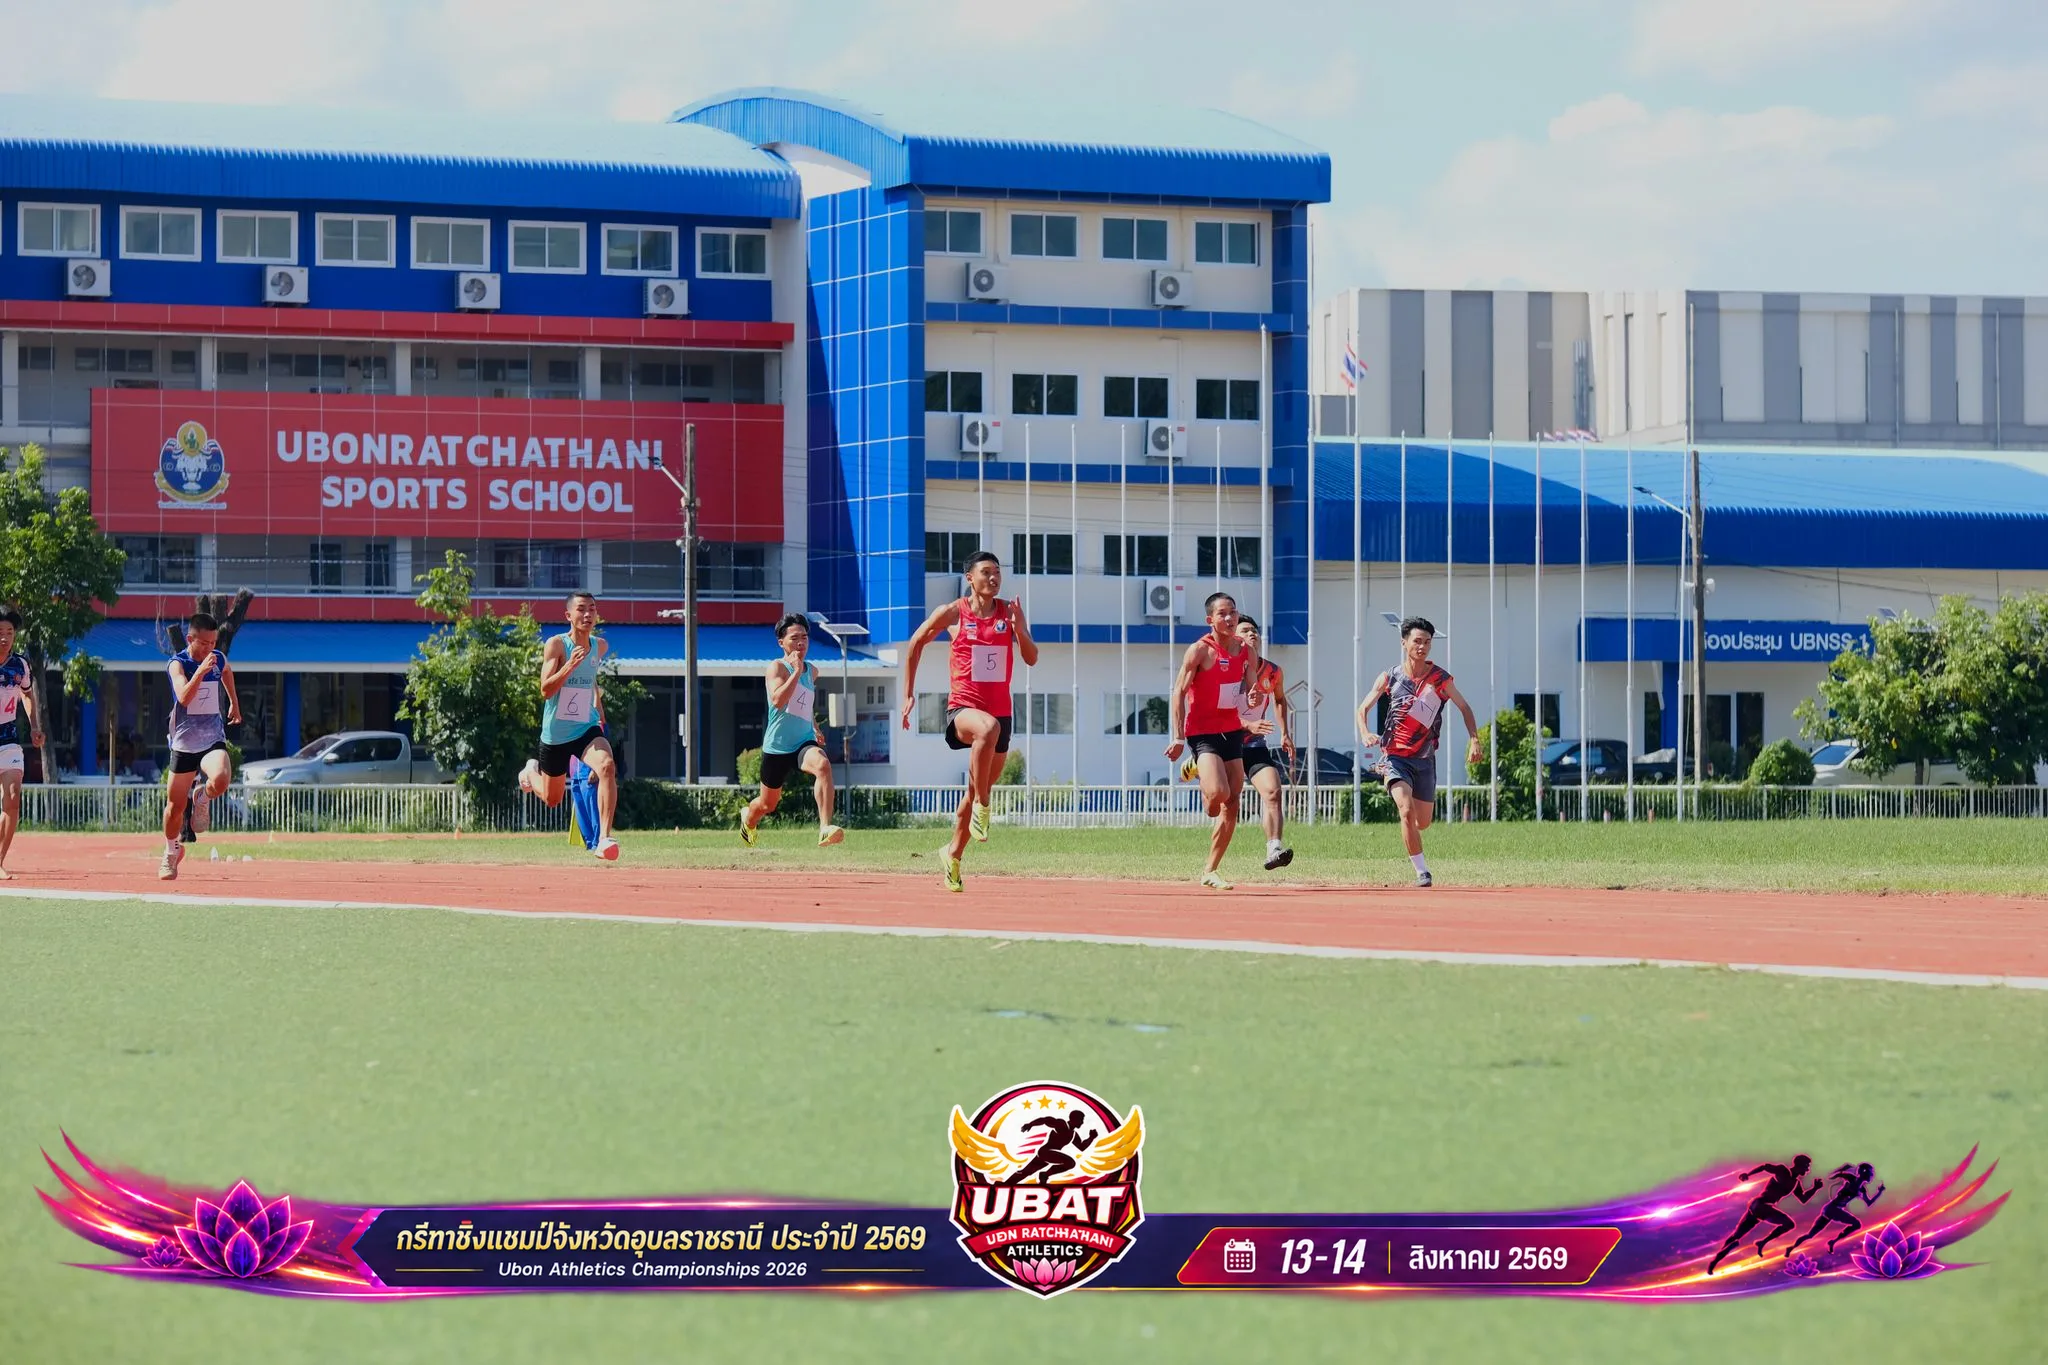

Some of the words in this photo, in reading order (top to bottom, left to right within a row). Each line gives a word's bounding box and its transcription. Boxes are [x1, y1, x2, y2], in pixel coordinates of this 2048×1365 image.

[277, 430, 665, 471] UBONRATCHATHANI
[323, 475, 467, 509] SPORTS
[489, 478, 634, 512] SCHOOL
[986, 652, 998, 671] 5
[4, 696, 16, 714] 4
[198, 687, 211, 708] 7
[567, 692, 579, 714] 6
[796, 689, 808, 710] 4
